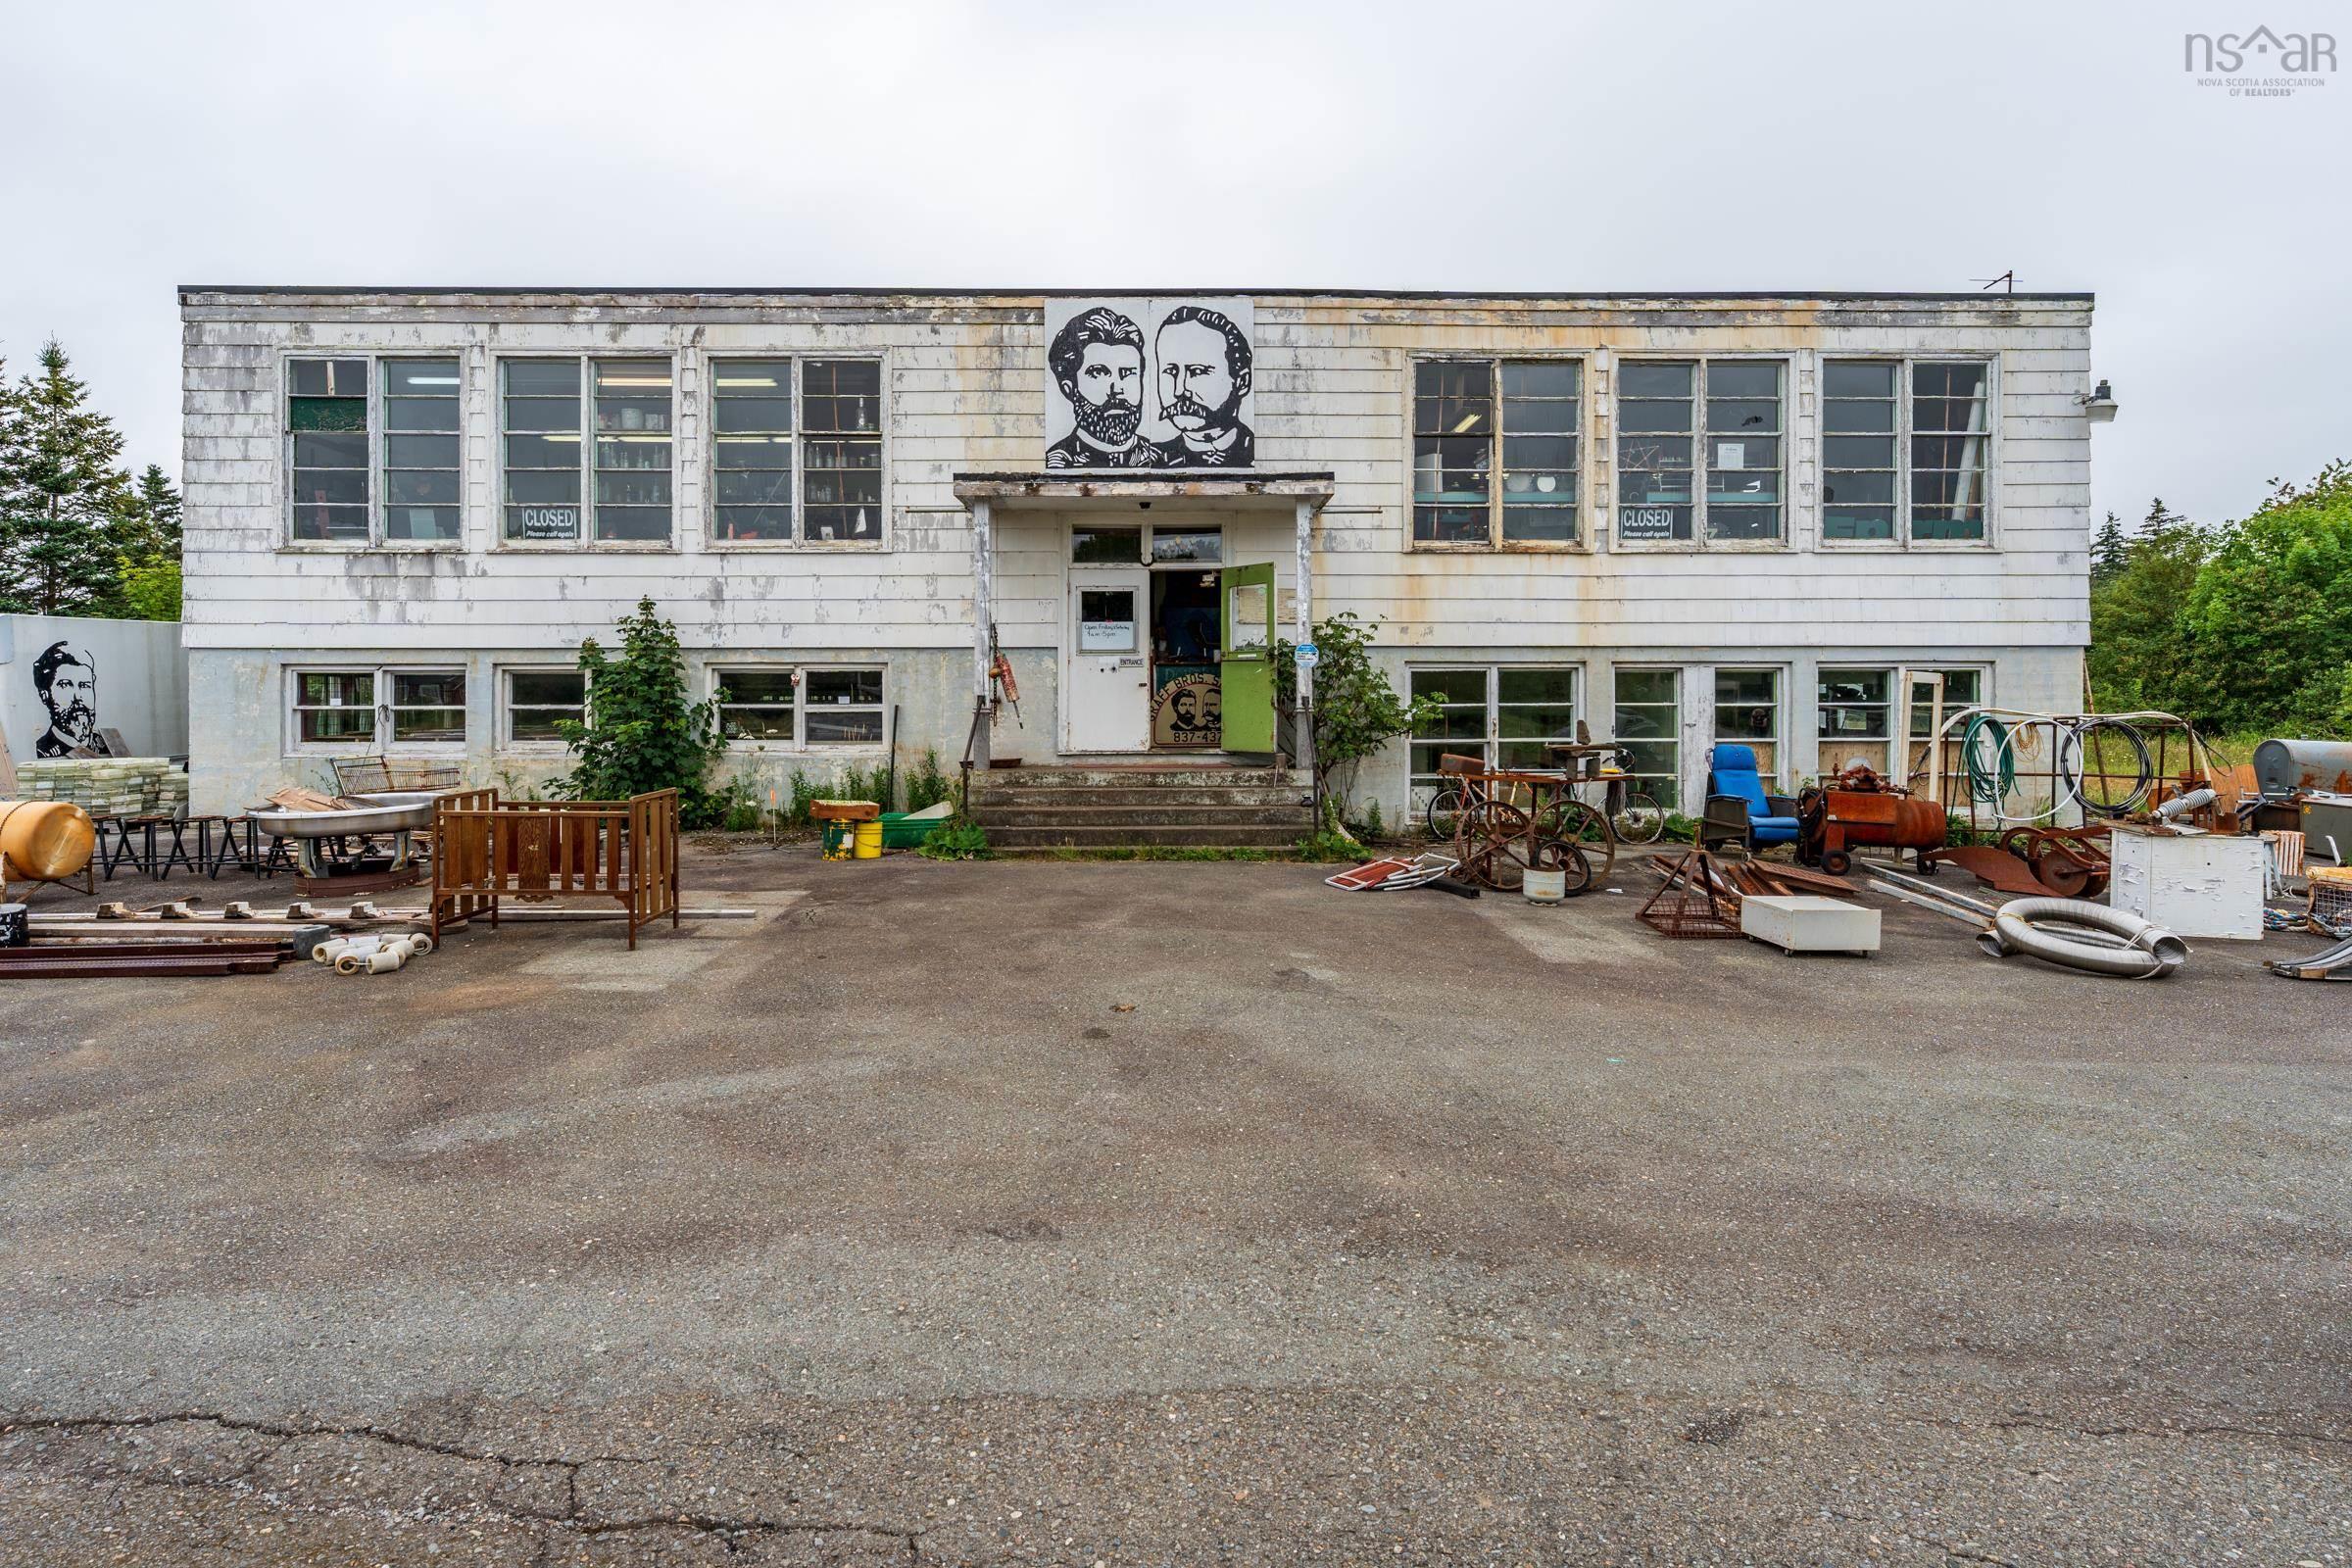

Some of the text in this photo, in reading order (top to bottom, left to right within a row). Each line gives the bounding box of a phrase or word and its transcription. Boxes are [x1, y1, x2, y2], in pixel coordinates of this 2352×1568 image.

[525, 510, 573, 526] CLOSED
[1624, 510, 1670, 526] CLOSED
[1174, 673, 1207, 689] BROS.
